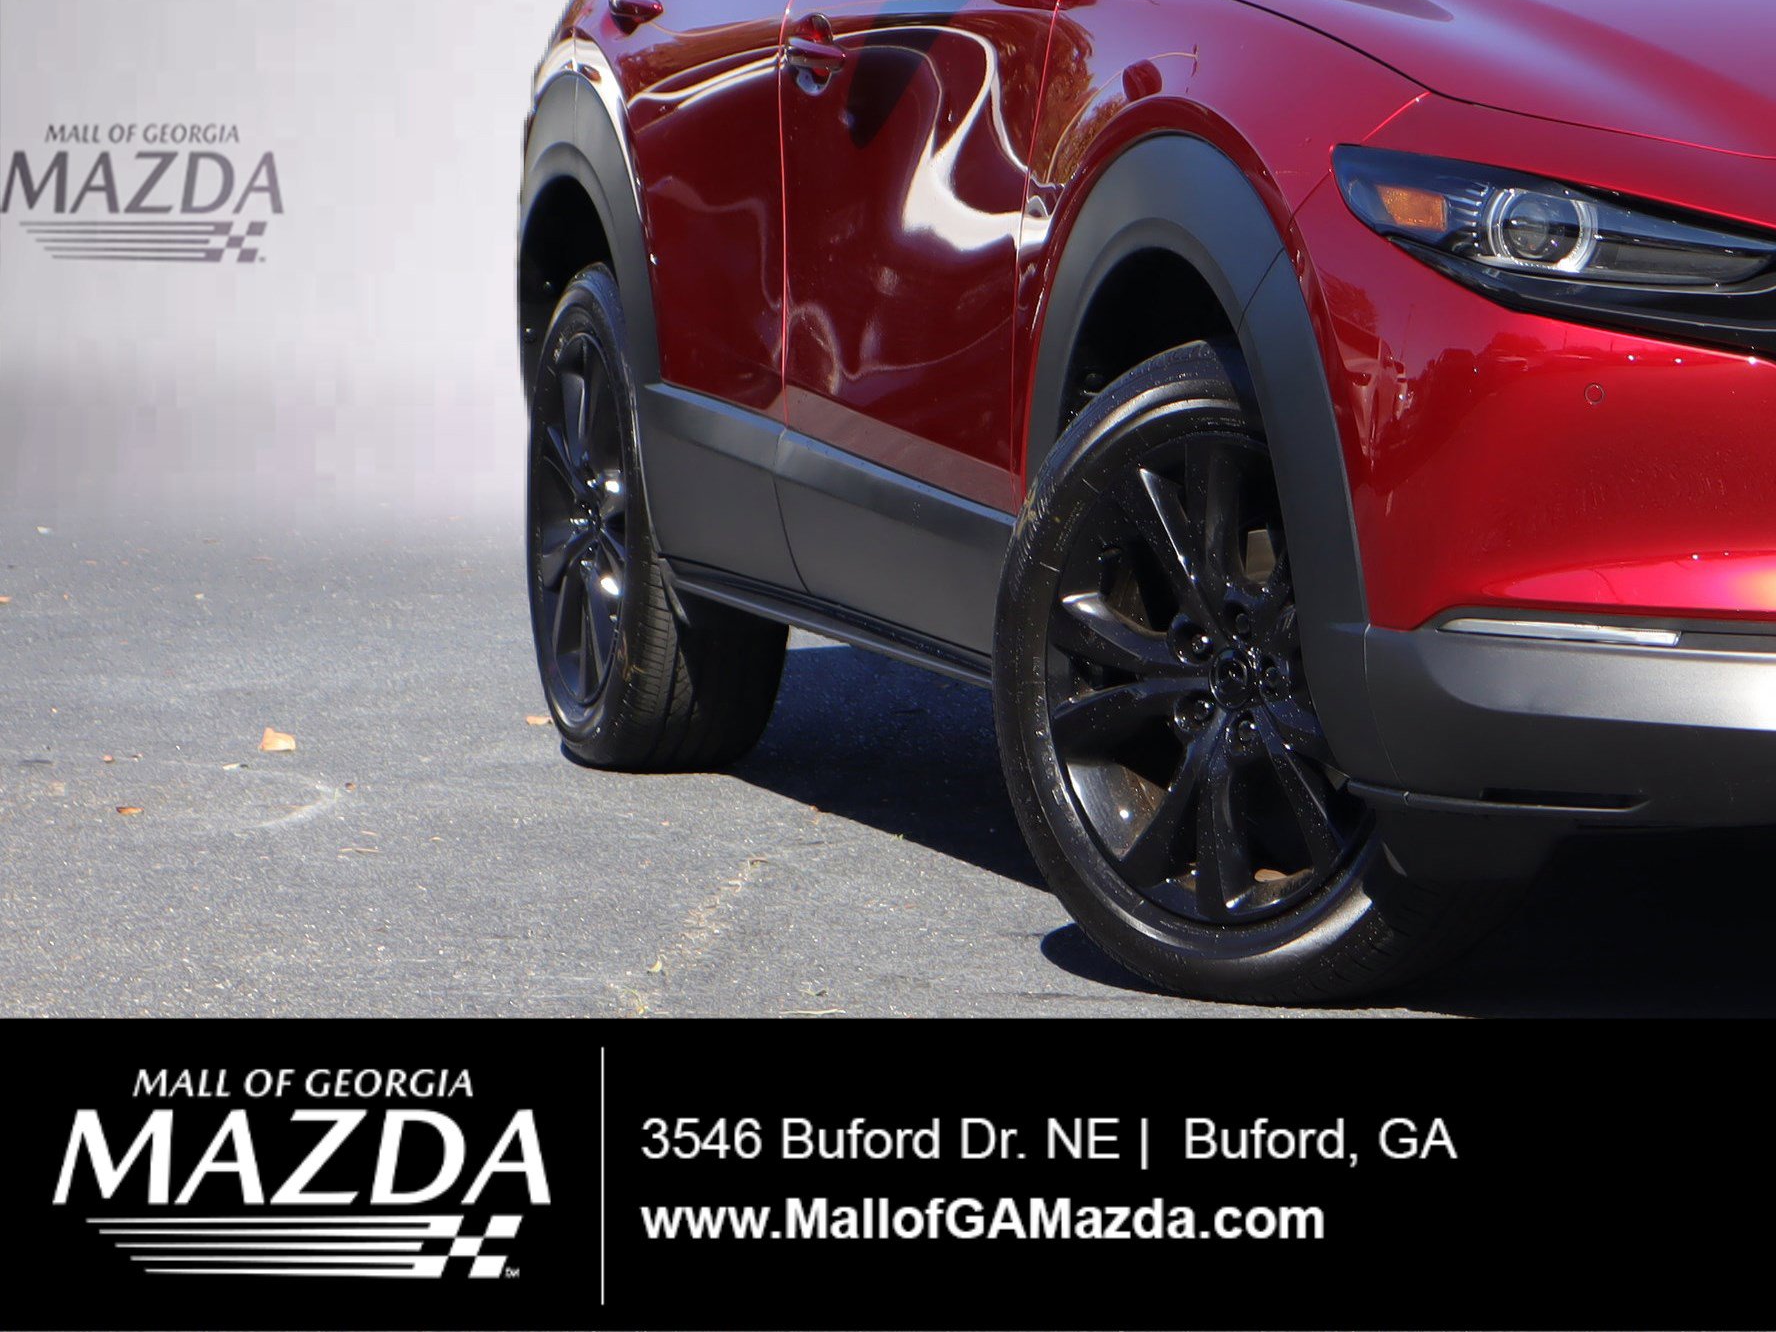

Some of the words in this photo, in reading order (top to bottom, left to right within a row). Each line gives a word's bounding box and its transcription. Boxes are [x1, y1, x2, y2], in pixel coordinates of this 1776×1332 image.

[45, 124, 99, 143] MALL
[108, 124, 136, 144] OF
[143, 123, 239, 144] GEORGIA
[0, 151, 283, 214] MAZDA
